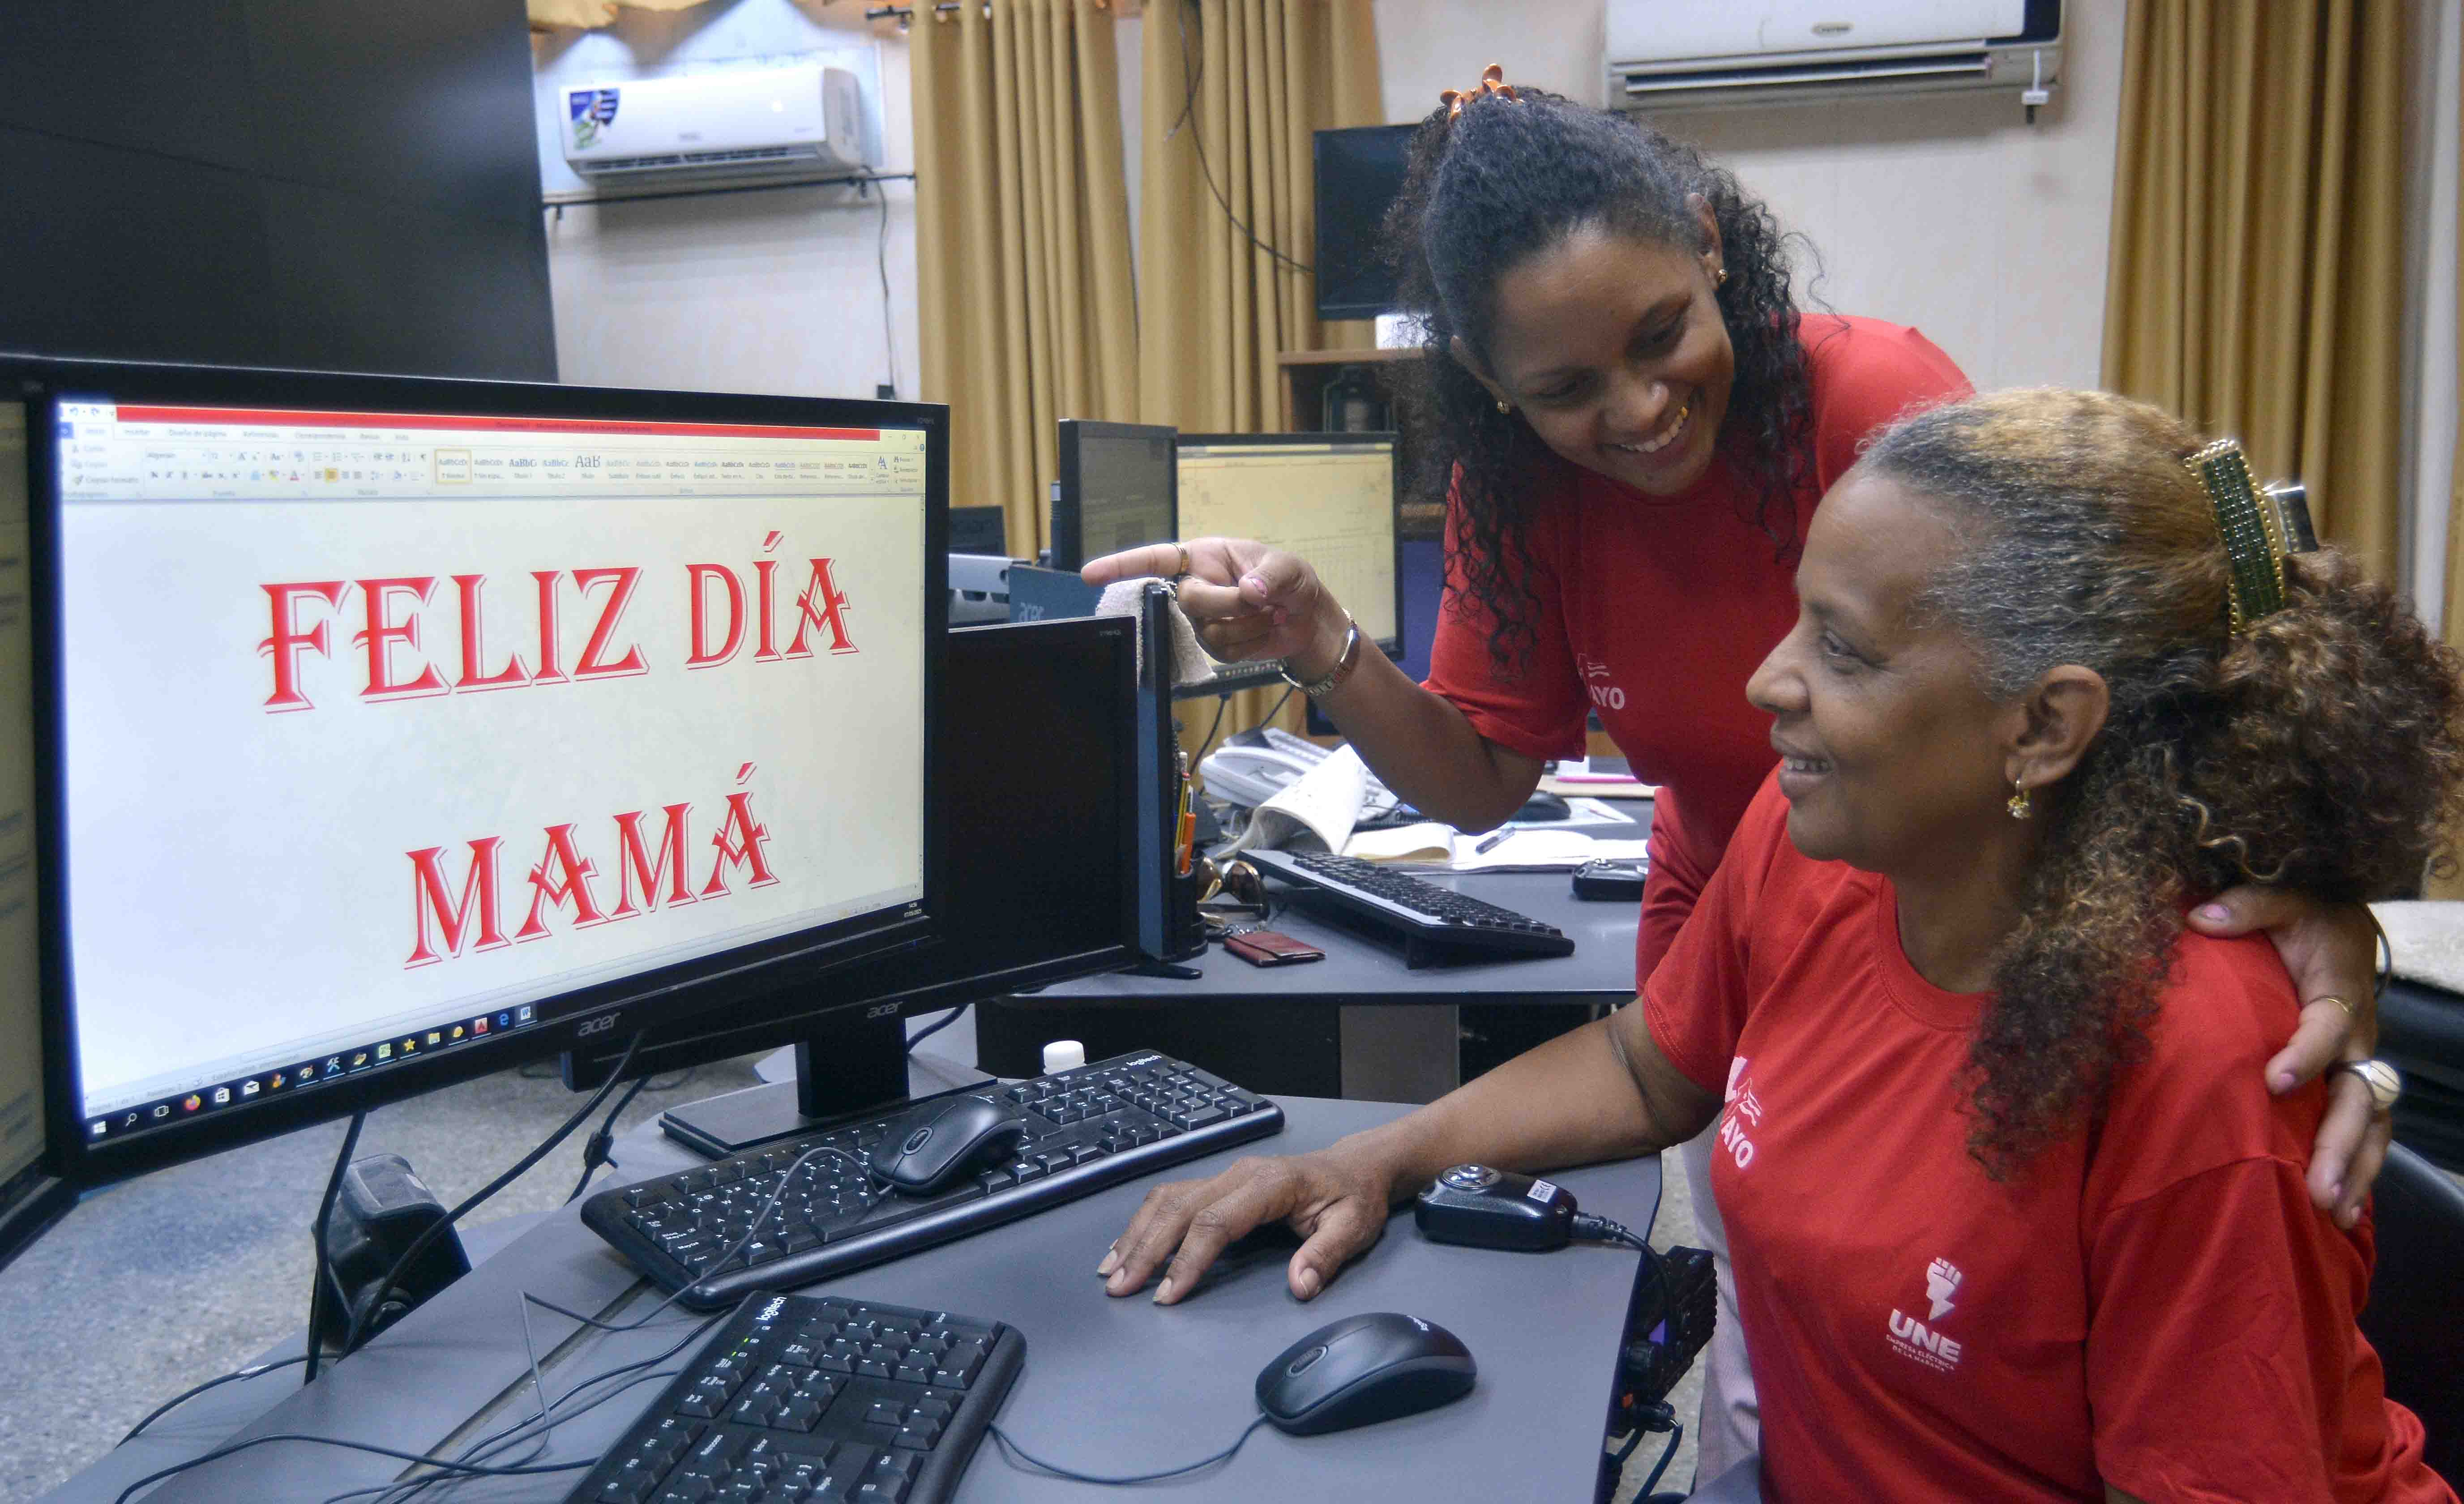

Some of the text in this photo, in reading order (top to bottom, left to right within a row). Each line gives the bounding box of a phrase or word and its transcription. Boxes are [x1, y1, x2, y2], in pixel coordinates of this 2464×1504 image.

[257, 530, 860, 714] FELIZ DÍA
[404, 761, 780, 970] MAMÁ
[867, 1000, 903, 1019] acer
[578, 1012, 620, 1037] acer
[1126, 1055, 1162, 1066] logitech
[756, 1297, 787, 1321] logitech
[1888, 1308, 1961, 1363] UNE
